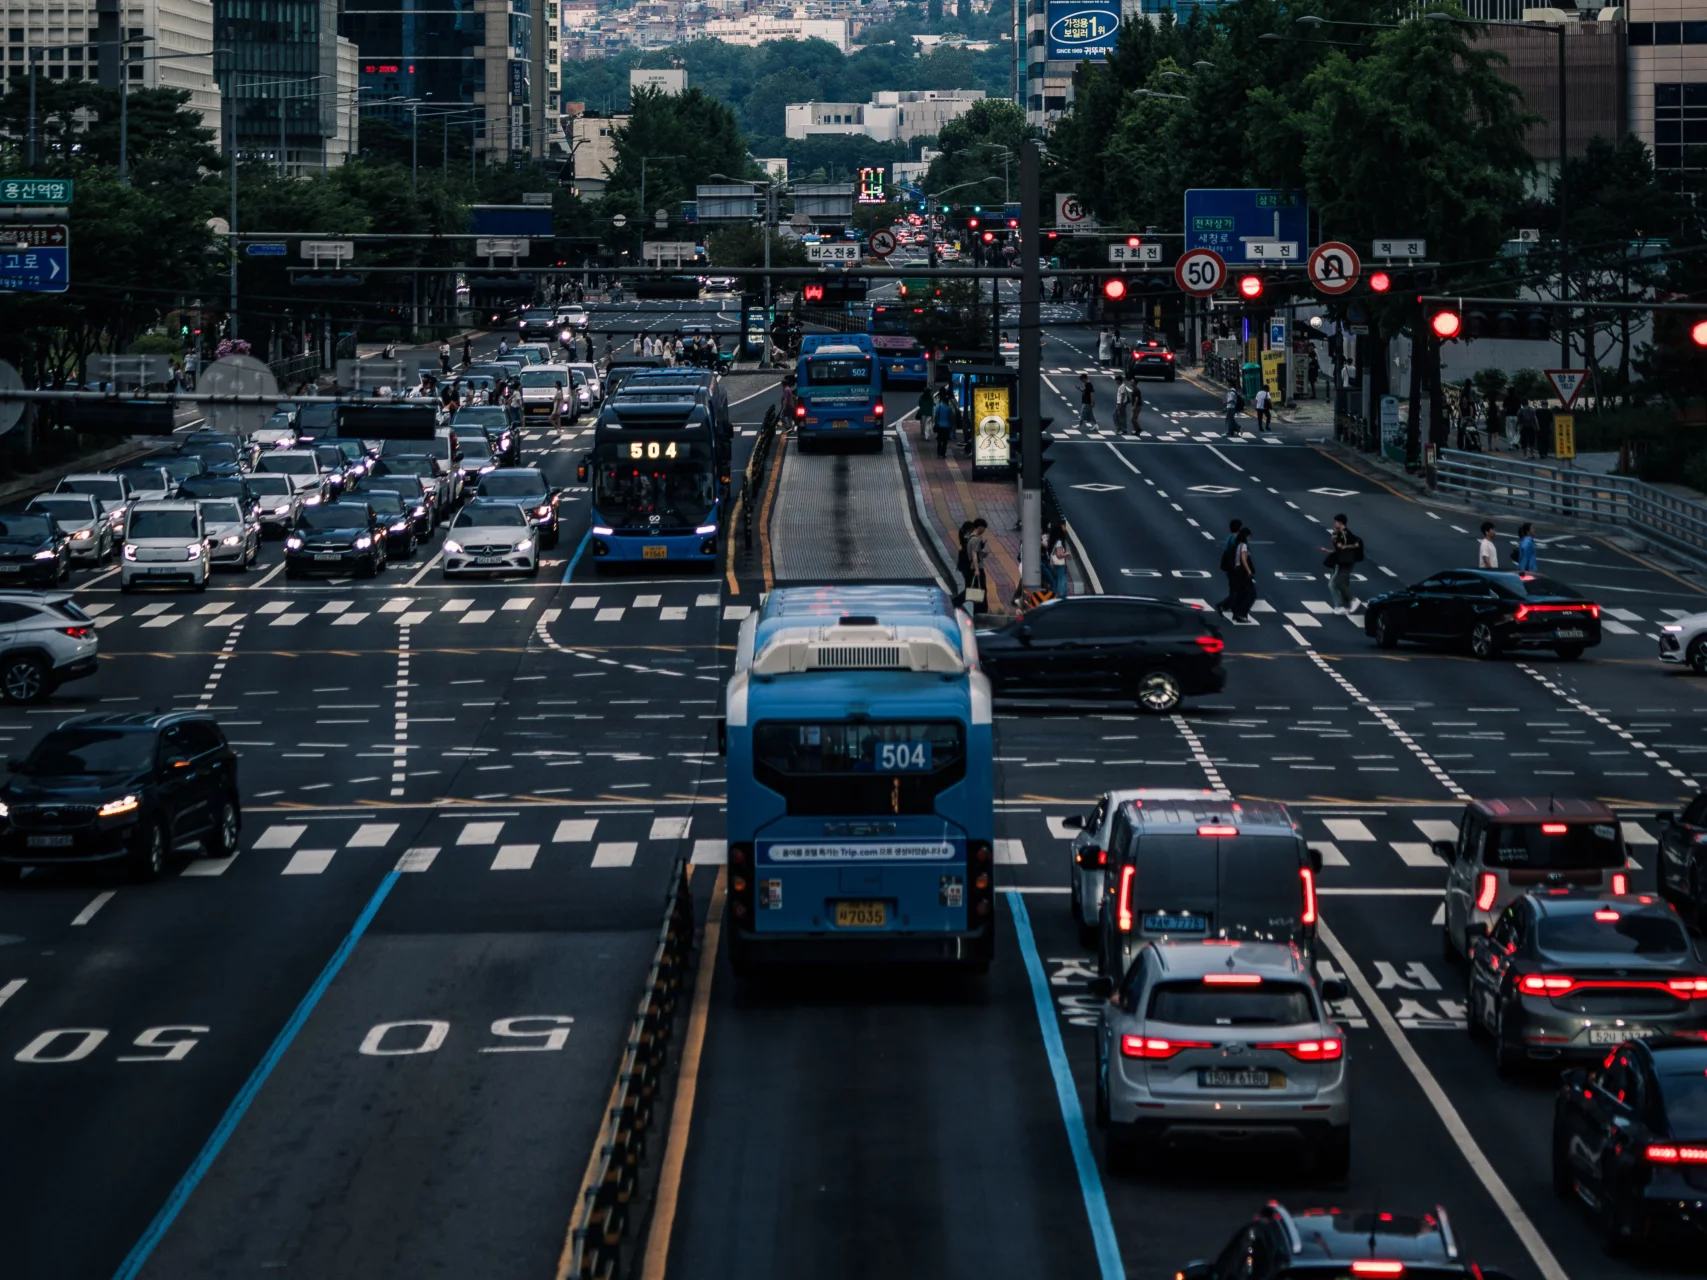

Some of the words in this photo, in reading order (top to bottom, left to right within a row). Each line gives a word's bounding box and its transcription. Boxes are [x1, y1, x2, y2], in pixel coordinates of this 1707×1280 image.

[1064, 18, 1088, 28] 가정용
[1064, 28, 1088, 38] 보일러
[4, 183, 65, 199] 용산역앞
[1196, 219, 1232, 228] 전자상가
[1199, 233, 1229, 244] 새창로
[811, 247, 856, 259] 버스전용
[0, 253, 40, 269] 고로
[1188, 261, 1215, 285] 50
[852, 368, 866, 377] 502
[1557, 374, 1576, 383] 양보
[984, 401, 1000, 410] 특별전
[630, 442, 678, 459] 504
[881, 741, 926, 770] 504
[804, 847, 818, 857] 호텔
[819, 847, 840, 857] 특가는
[841, 846, 878, 858] Trip.com
[879, 846, 893, 856] 으로
